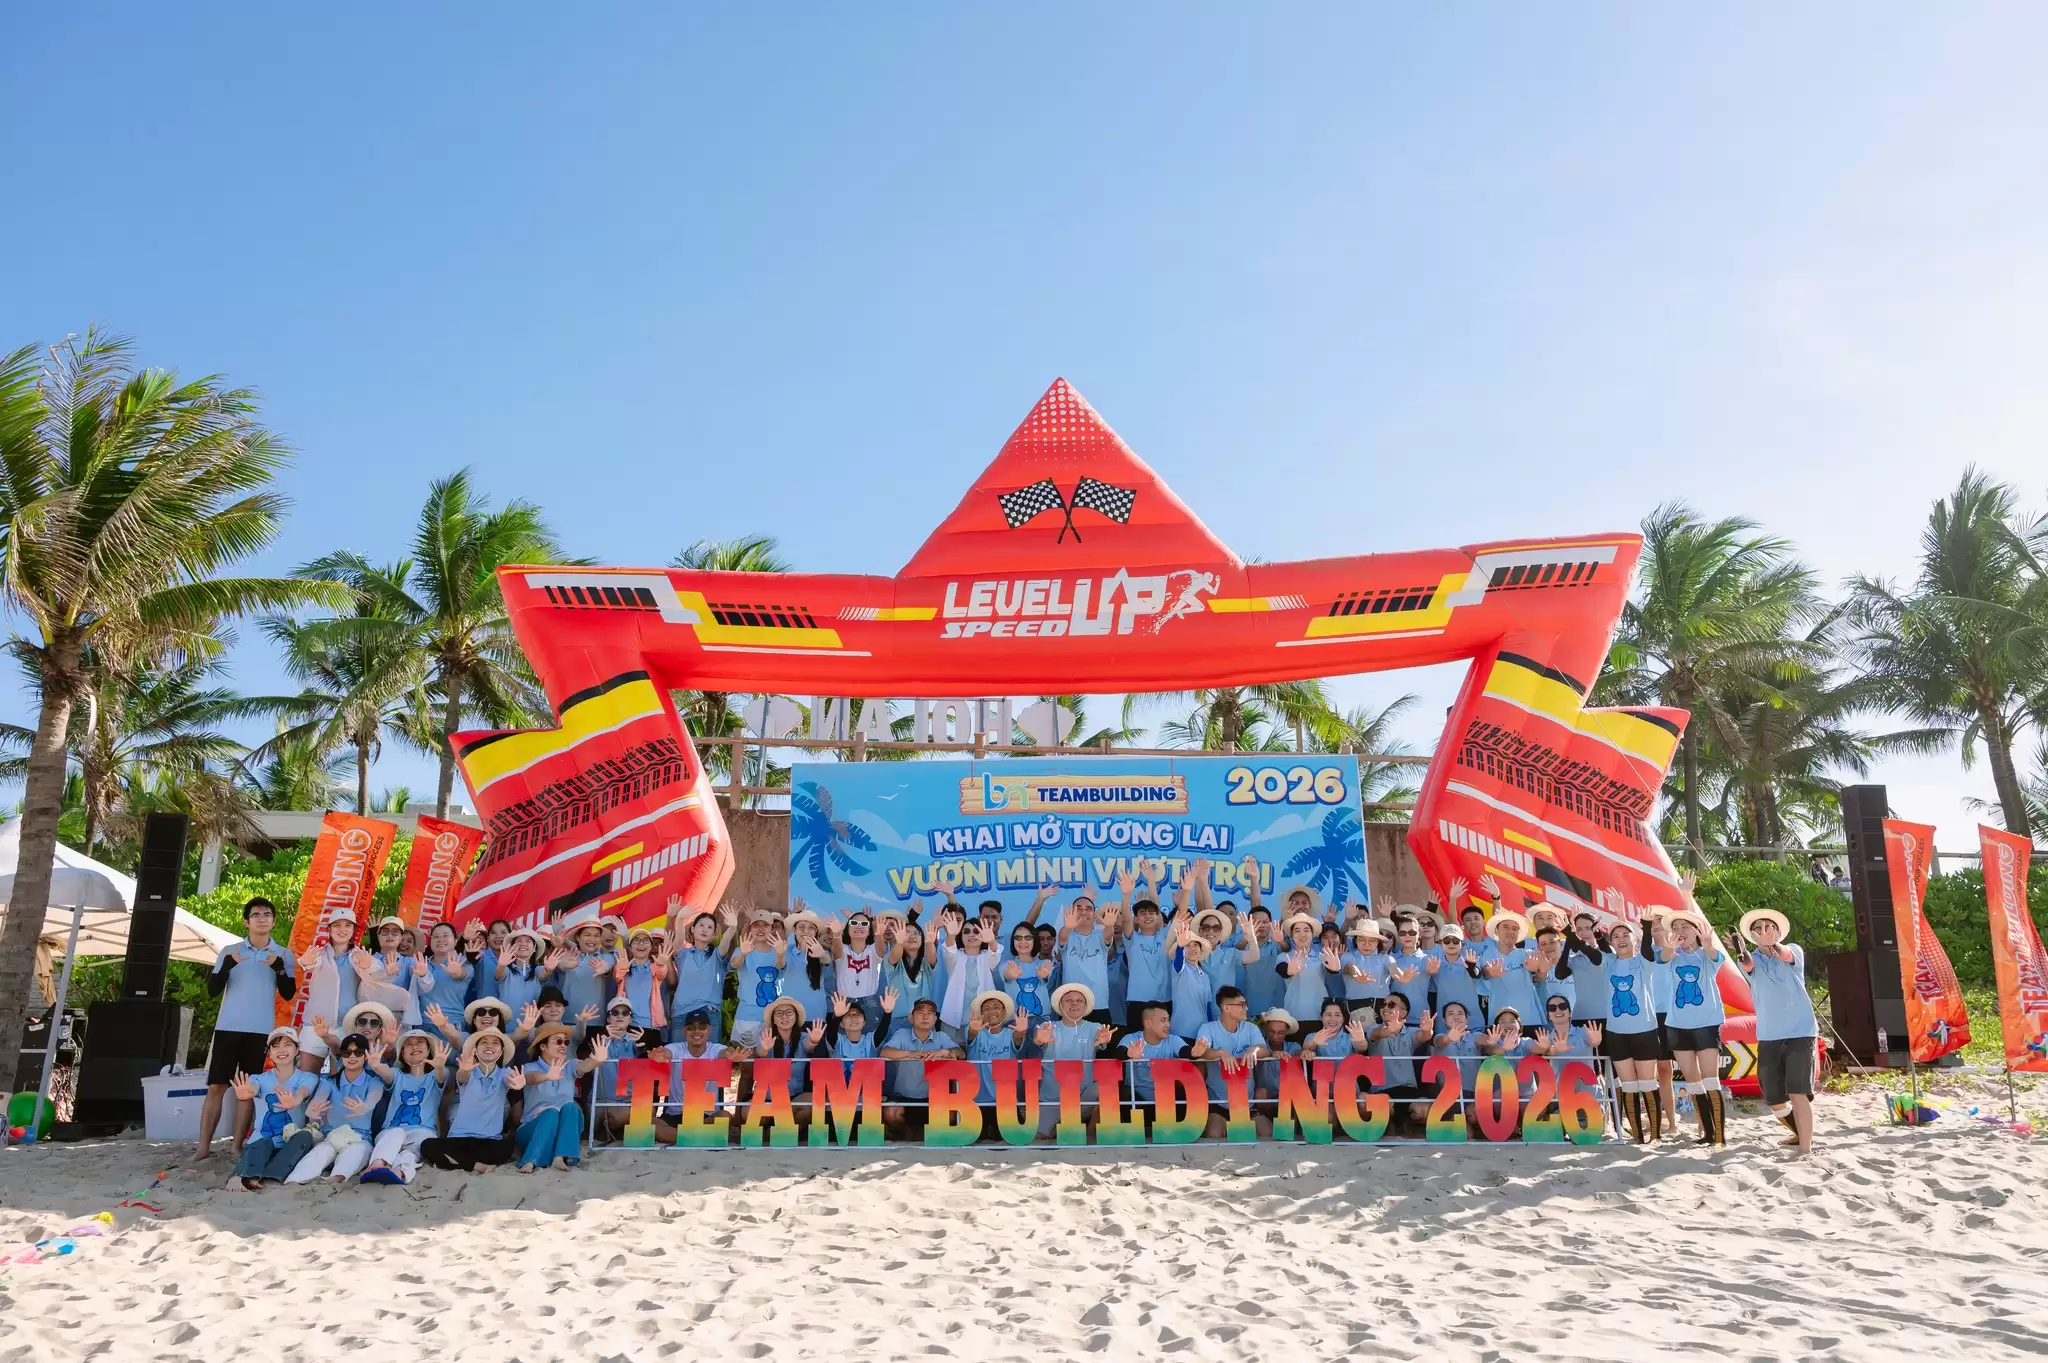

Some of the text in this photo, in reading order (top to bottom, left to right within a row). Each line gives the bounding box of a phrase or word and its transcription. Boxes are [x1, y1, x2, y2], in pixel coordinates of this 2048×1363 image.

[942, 567, 1168, 636] LEVEL UP
[940, 619, 1069, 639] SPEED
[1037, 785, 1177, 803] TEAMBUILDING
[1226, 766, 1347, 806] 2026
[455, 839, 471, 868] SUCCESS
[932, 814, 1231, 855] KHAI MỞ TƯƠNG LAI
[364, 869, 374, 890] YOUR
[370, 836, 384, 869] SUCCESS
[887, 859, 988, 897] VƯƠN
[997, 849, 1085, 889] MÌNH
[616, 1054, 1603, 1148] TEAM BUILDING 2026
